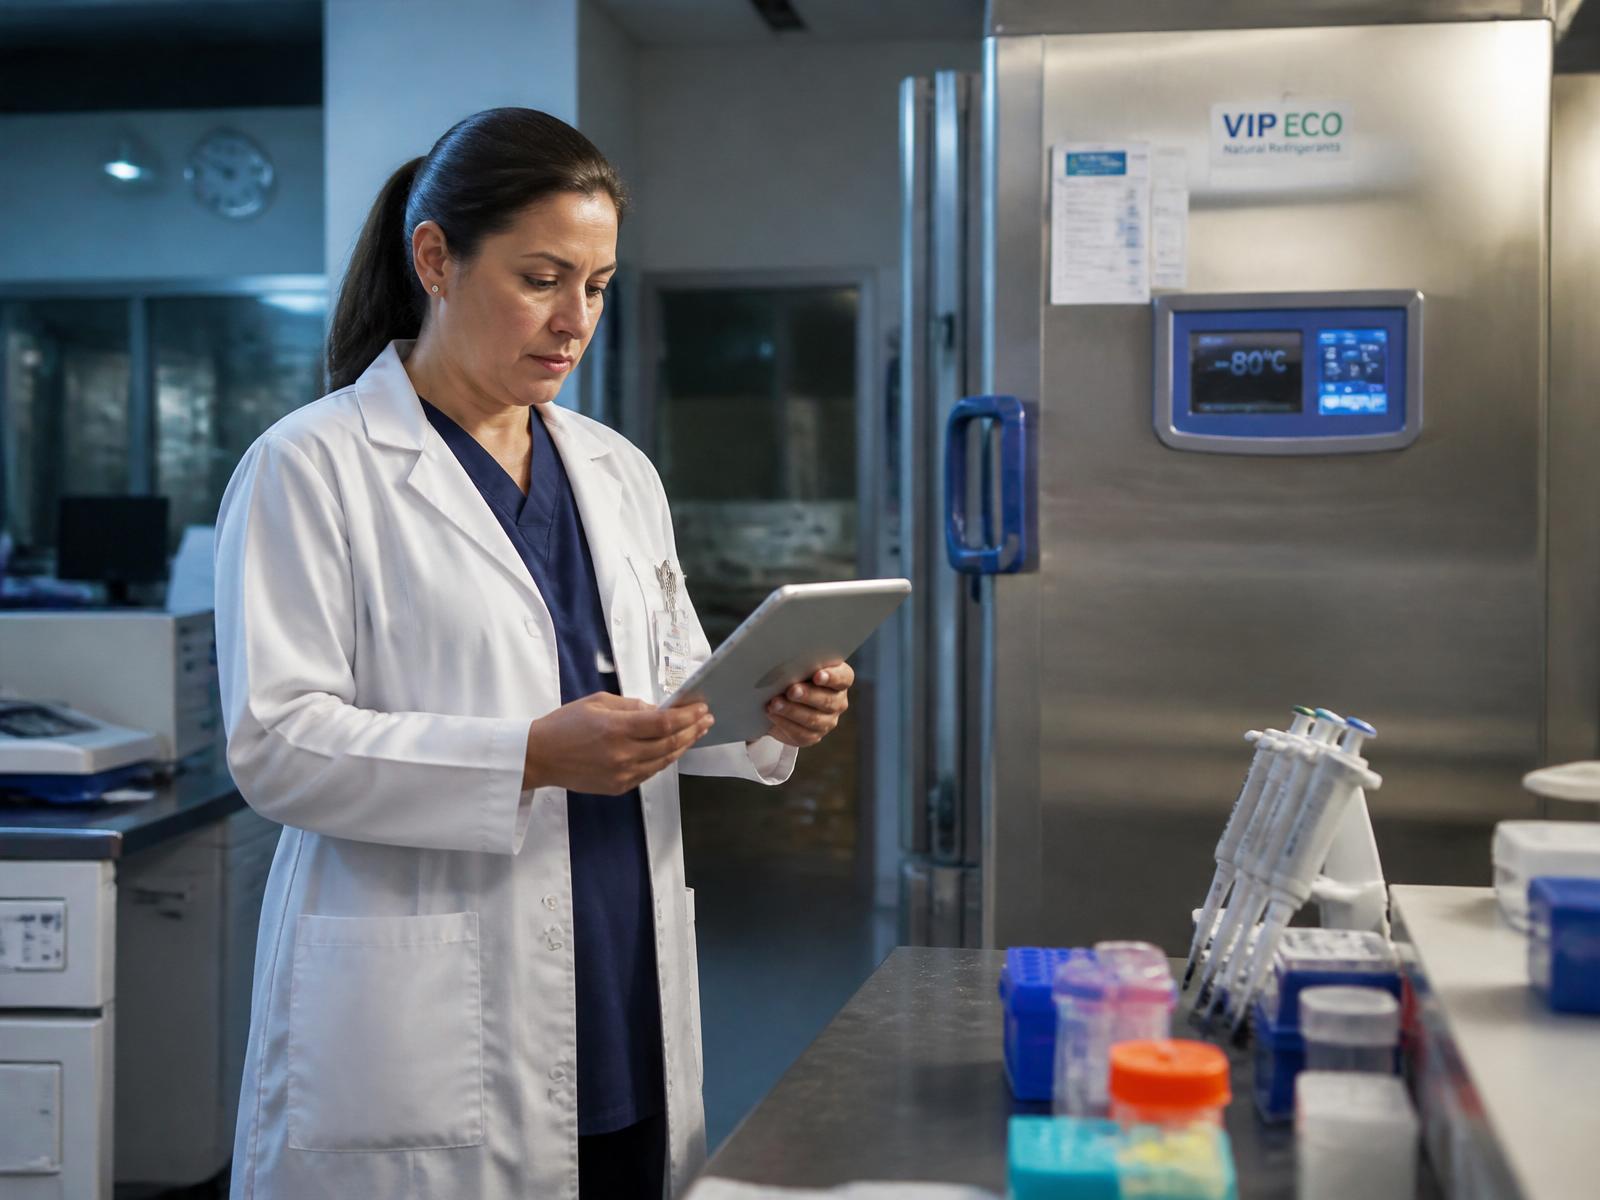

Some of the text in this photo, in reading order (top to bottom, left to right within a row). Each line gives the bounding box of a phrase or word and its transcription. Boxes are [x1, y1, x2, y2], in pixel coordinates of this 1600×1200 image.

[1222, 111, 1343, 138] VIP ECO
[1223, 142, 1341, 155] Natural Refrigerants
